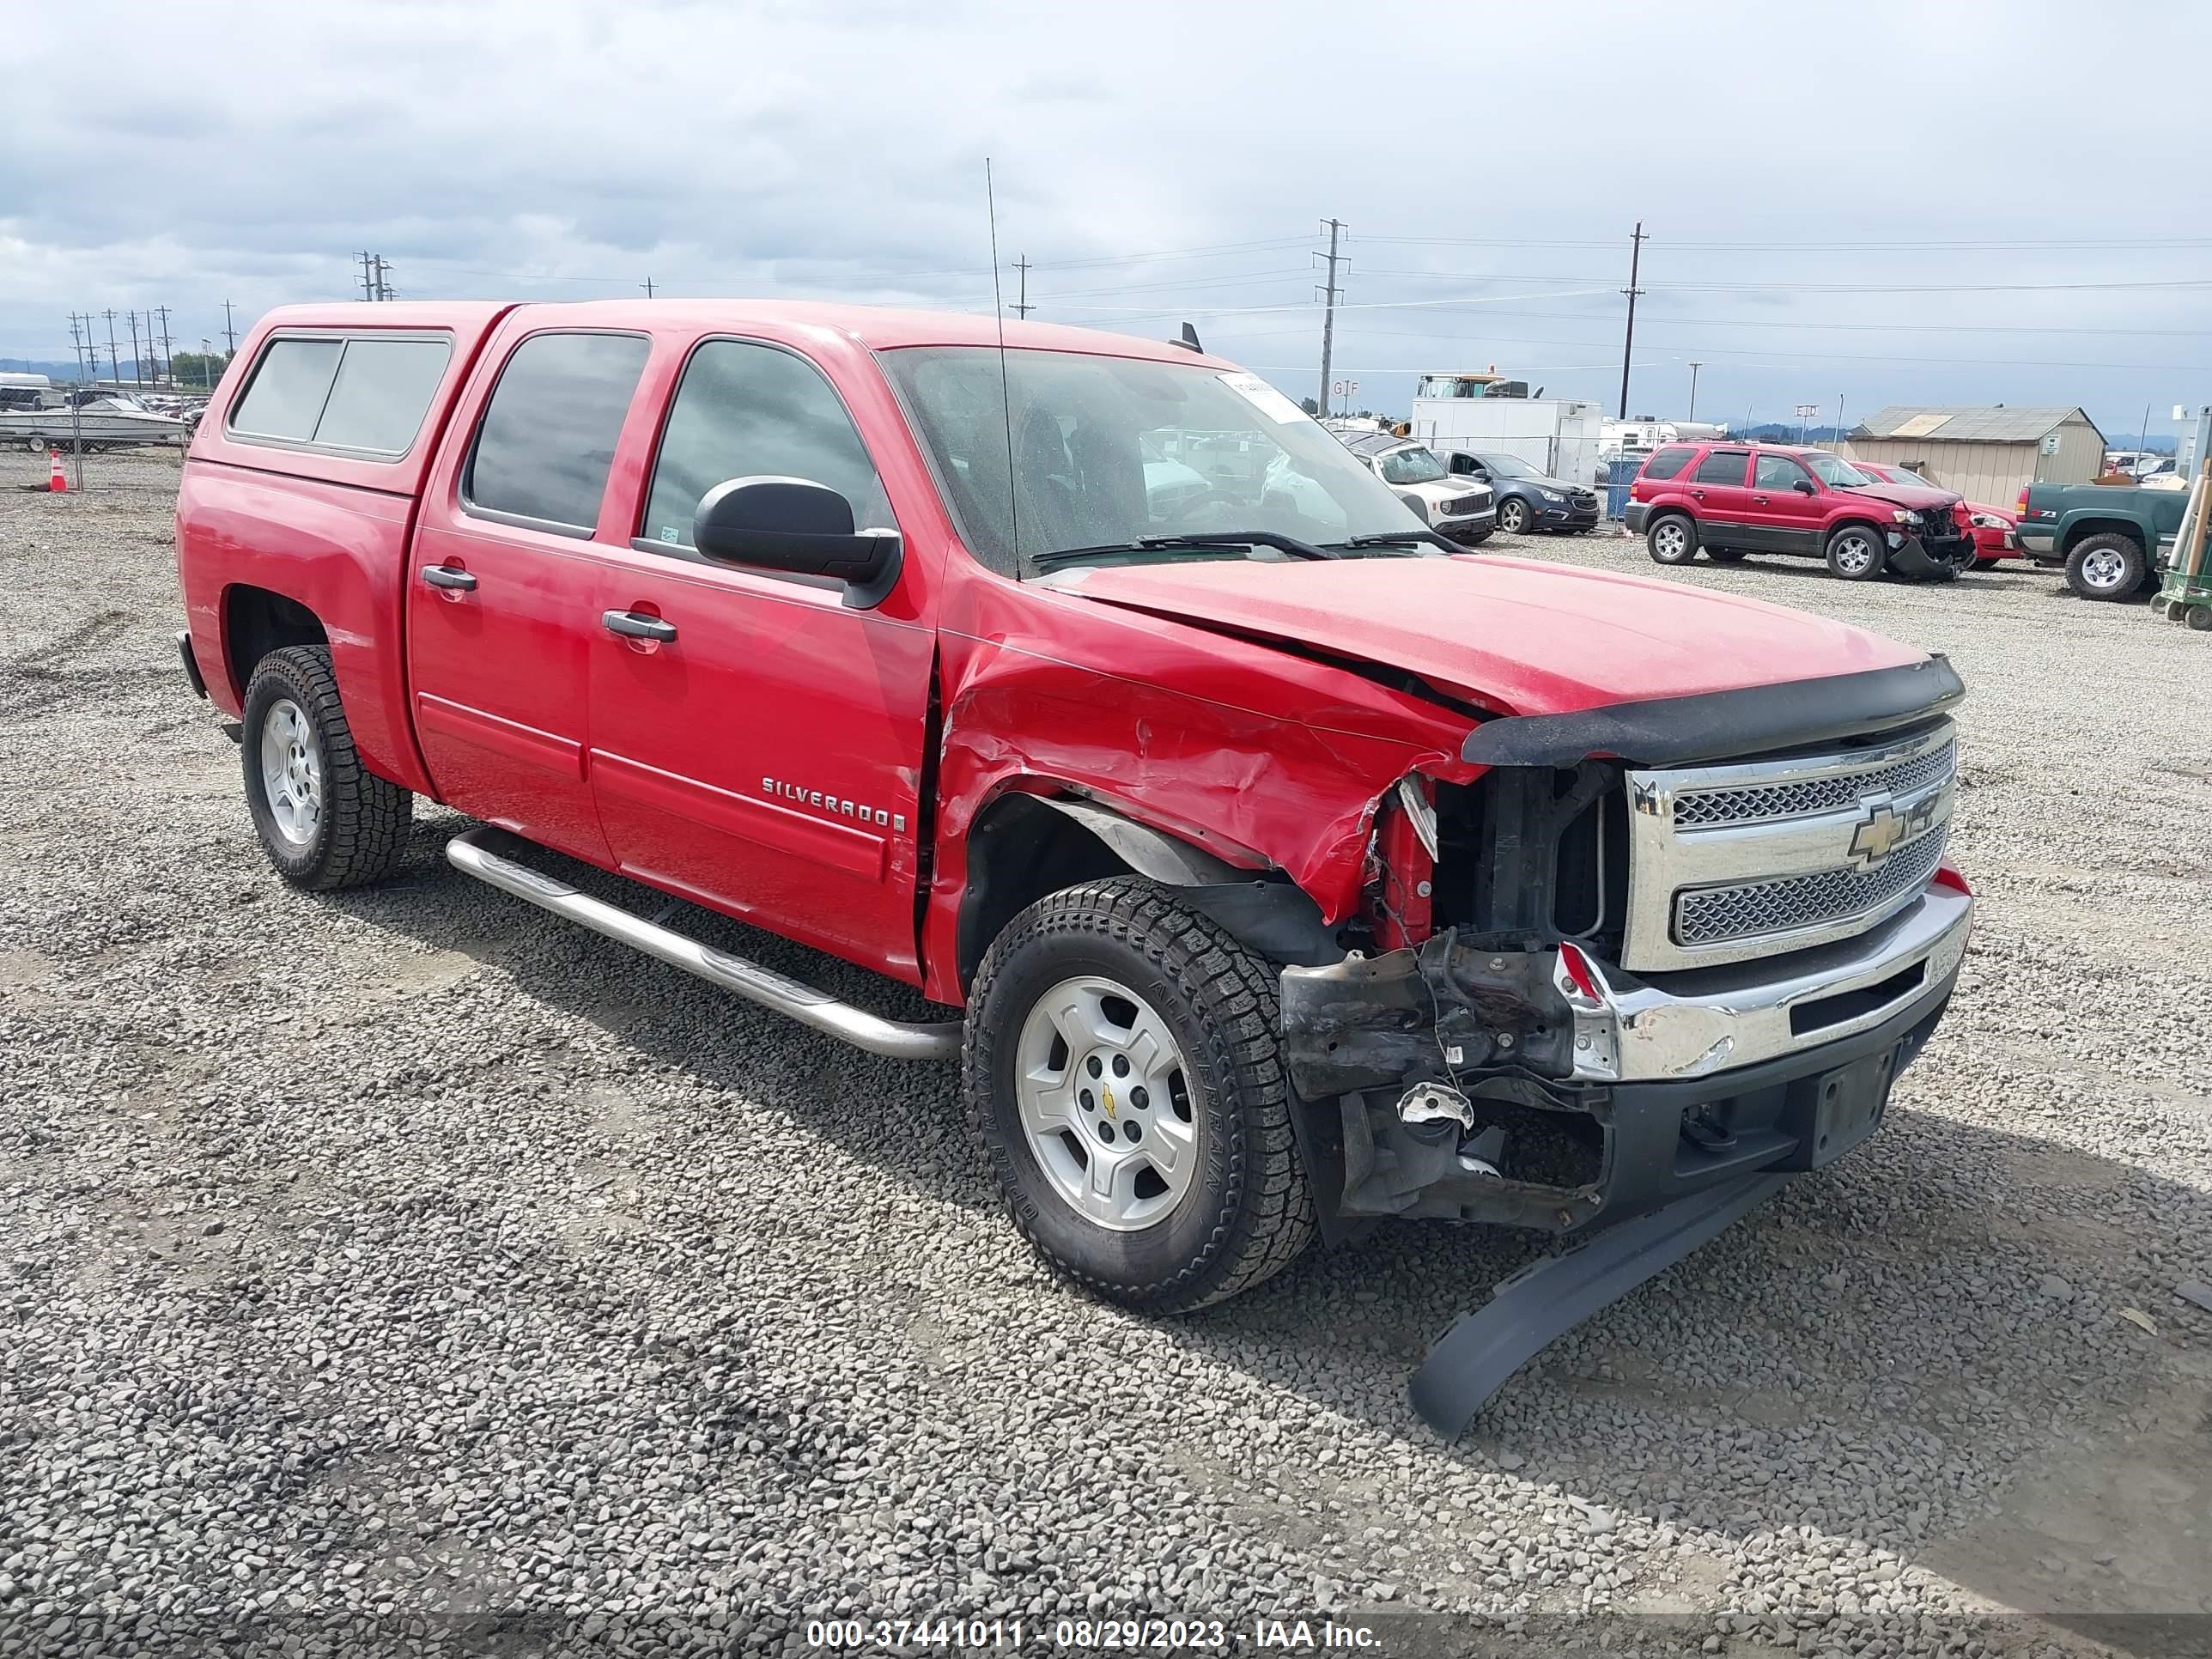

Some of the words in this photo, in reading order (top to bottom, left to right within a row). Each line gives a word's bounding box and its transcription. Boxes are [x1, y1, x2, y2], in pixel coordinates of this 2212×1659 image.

[763, 777, 889, 827] SILVERADO
[976, 1026, 997, 1131] RANGE
[1148, 980, 1190, 1038] ALL
[1188, 1041, 1224, 1197] TERRAIN
[991, 1145, 1039, 1223] OPEN
